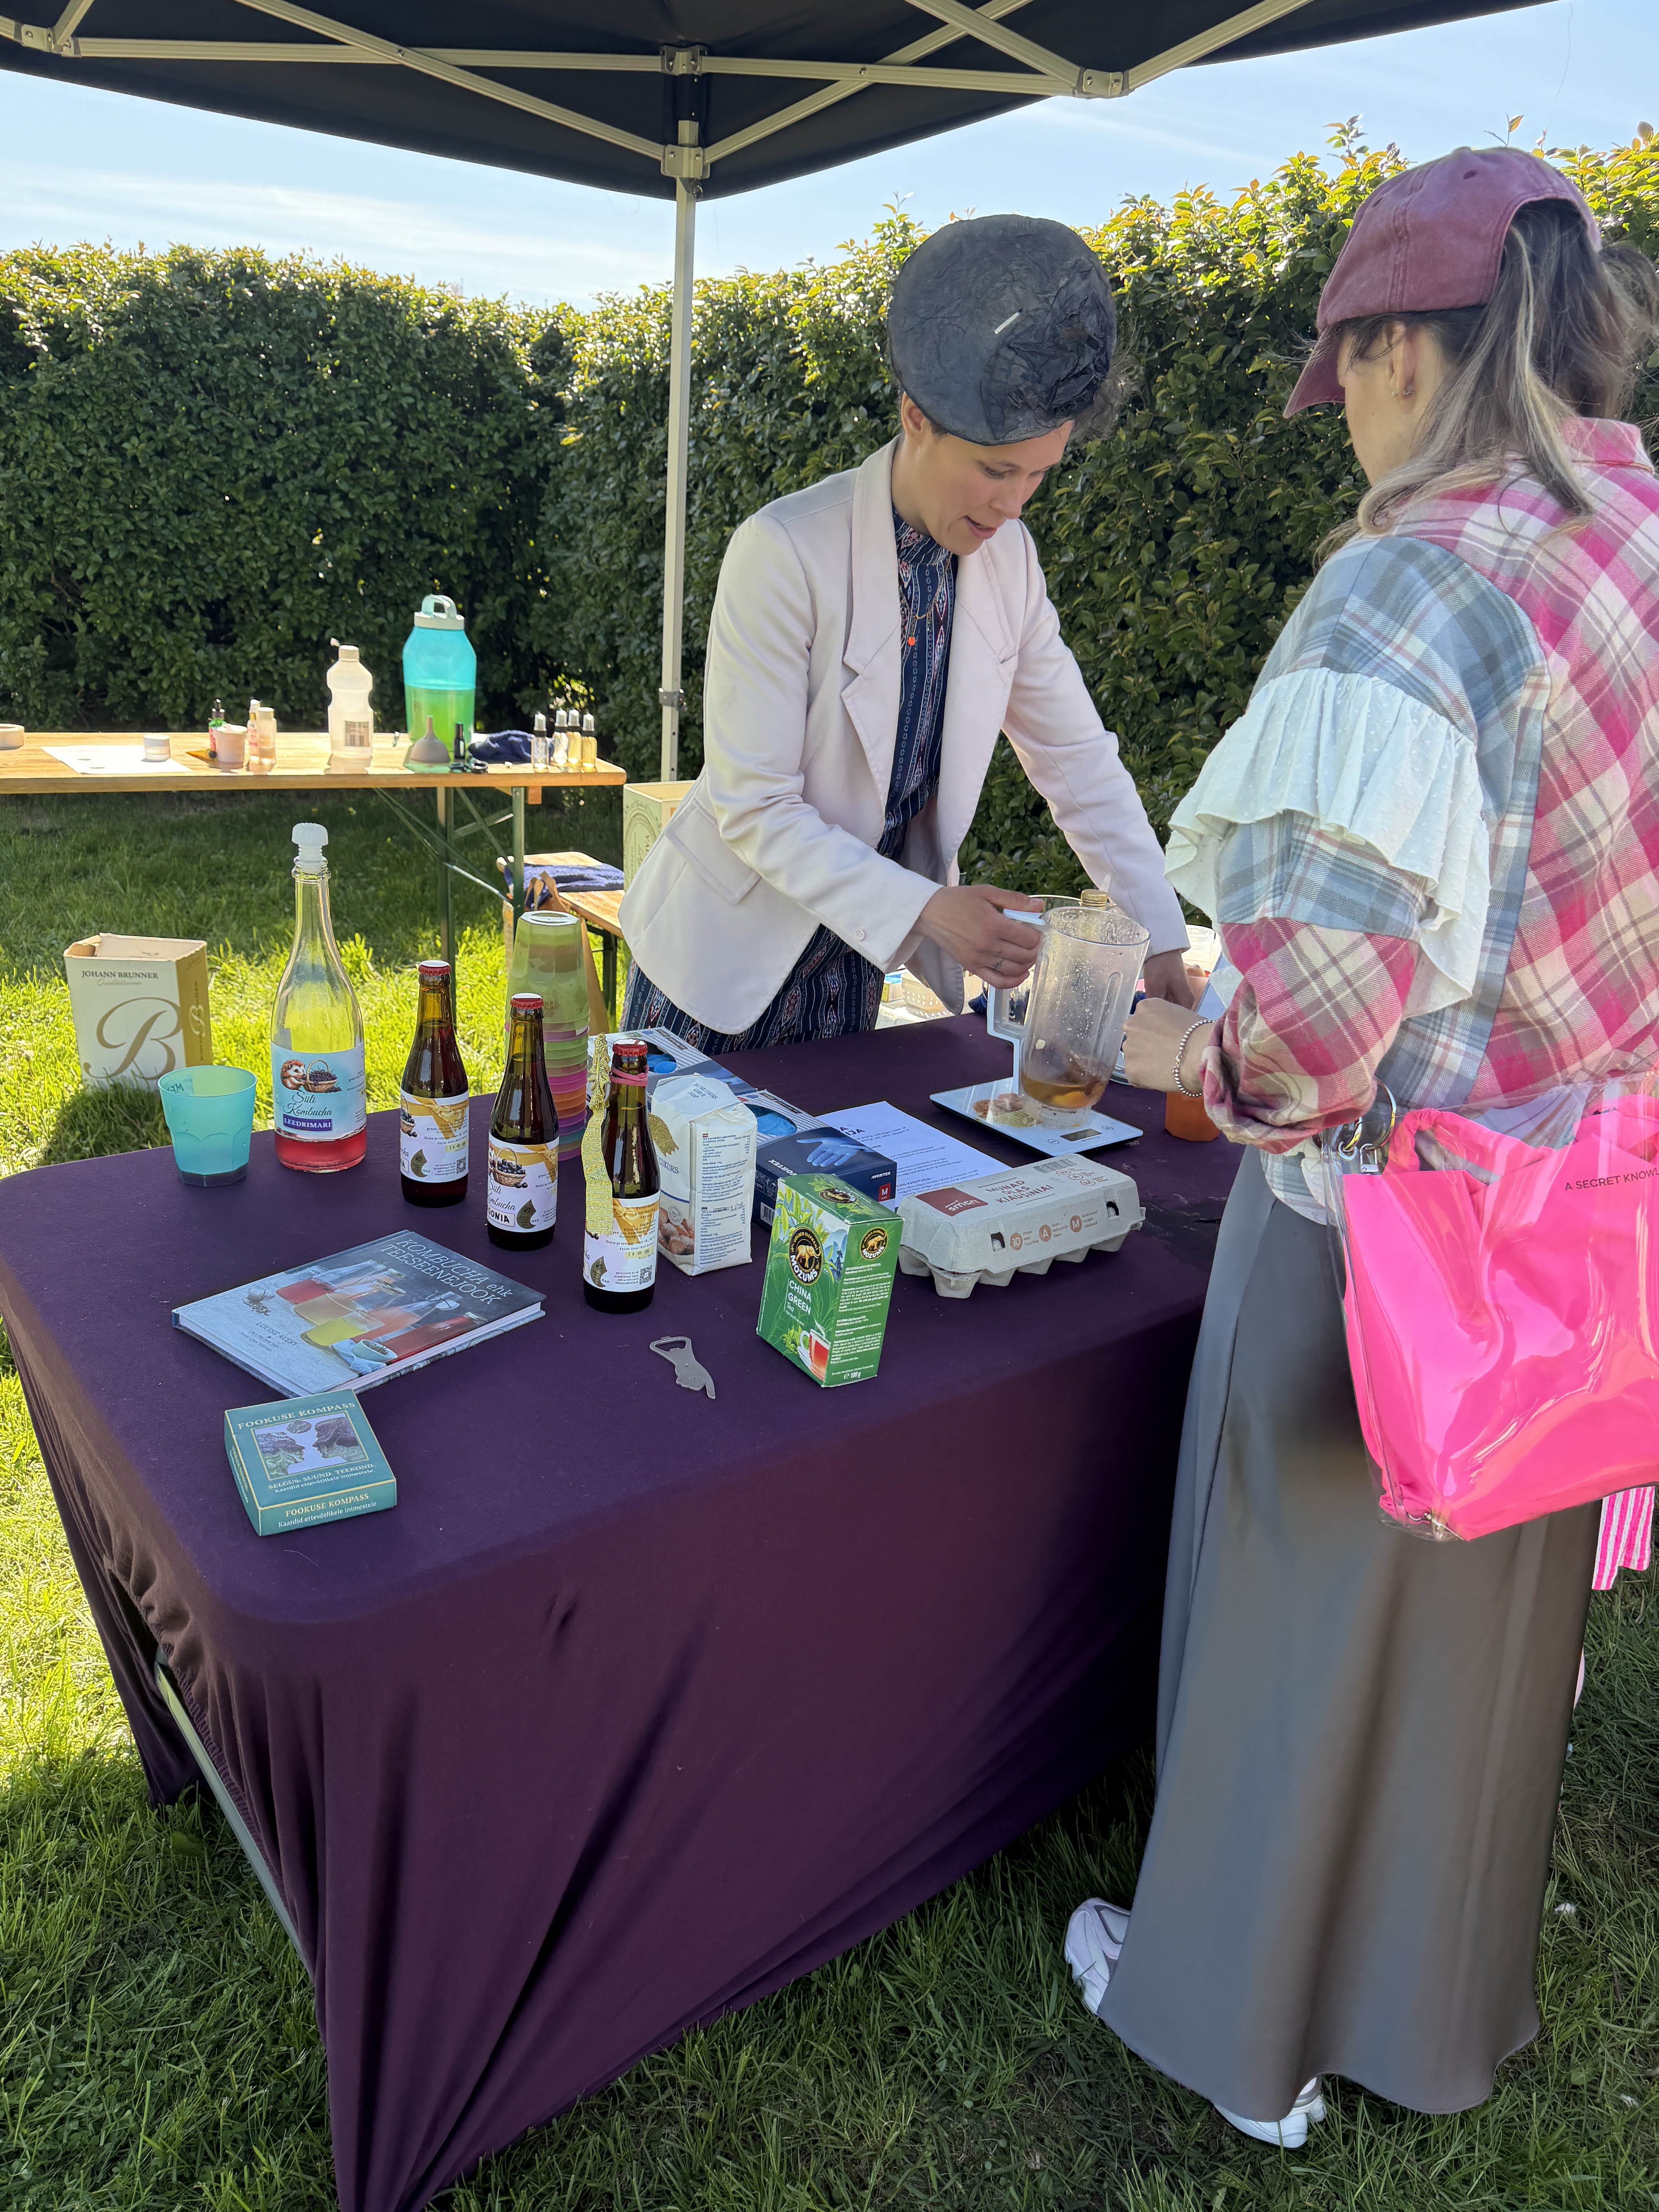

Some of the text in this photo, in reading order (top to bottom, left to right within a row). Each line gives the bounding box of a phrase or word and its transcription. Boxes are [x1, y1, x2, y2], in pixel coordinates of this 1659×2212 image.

[82, 970, 116, 979] JOHANN
[283, 1103, 333, 1116] Kombucha
[284, 1118, 331, 1128] LEEDRIMARI
[659, 1157, 679, 1174] CUKURS
[986, 1180, 1025, 1192] MUNAD
[1565, 1167, 1659, 1191] A SECRET KNOWL
[881, 1187, 888, 1196] M
[1002, 1186, 1030, 1194] OLAS
[1042, 1228, 1049, 1238] A
[1072, 1219, 1080, 1229] M
[793, 1231, 819, 1250] GOLDEN ELEPHANT
[1012, 1237, 1020, 1247] 10
[862, 1245, 885, 1259] MOZUMS
[381, 1244, 501, 1304] TEESEENEJOOK
[396, 1239, 513, 1297] KOMBUCHA ehk
[790, 1255, 817, 1282] MOZUMS
[789, 1279, 812, 1303] CHINA
[788, 1292, 811, 1315] GREEN
[256, 1322, 280, 1336] LOUISE
[278, 1335, 299, 1346] AVERY
[238, 1402, 356, 1429] FOOKUSE KOMPASS
[275, 1469, 373, 1493] Kaardid ettevõtlikele inimestele
[303, 1472, 333, 1481] SUUND.
[335, 1464, 376, 1475] TEEKOND.
[285, 1493, 369, 1517] FOOKUSE KOMPASS
[278, 1501, 377, 1528] Kaardid ettevõtlikele inimestele
